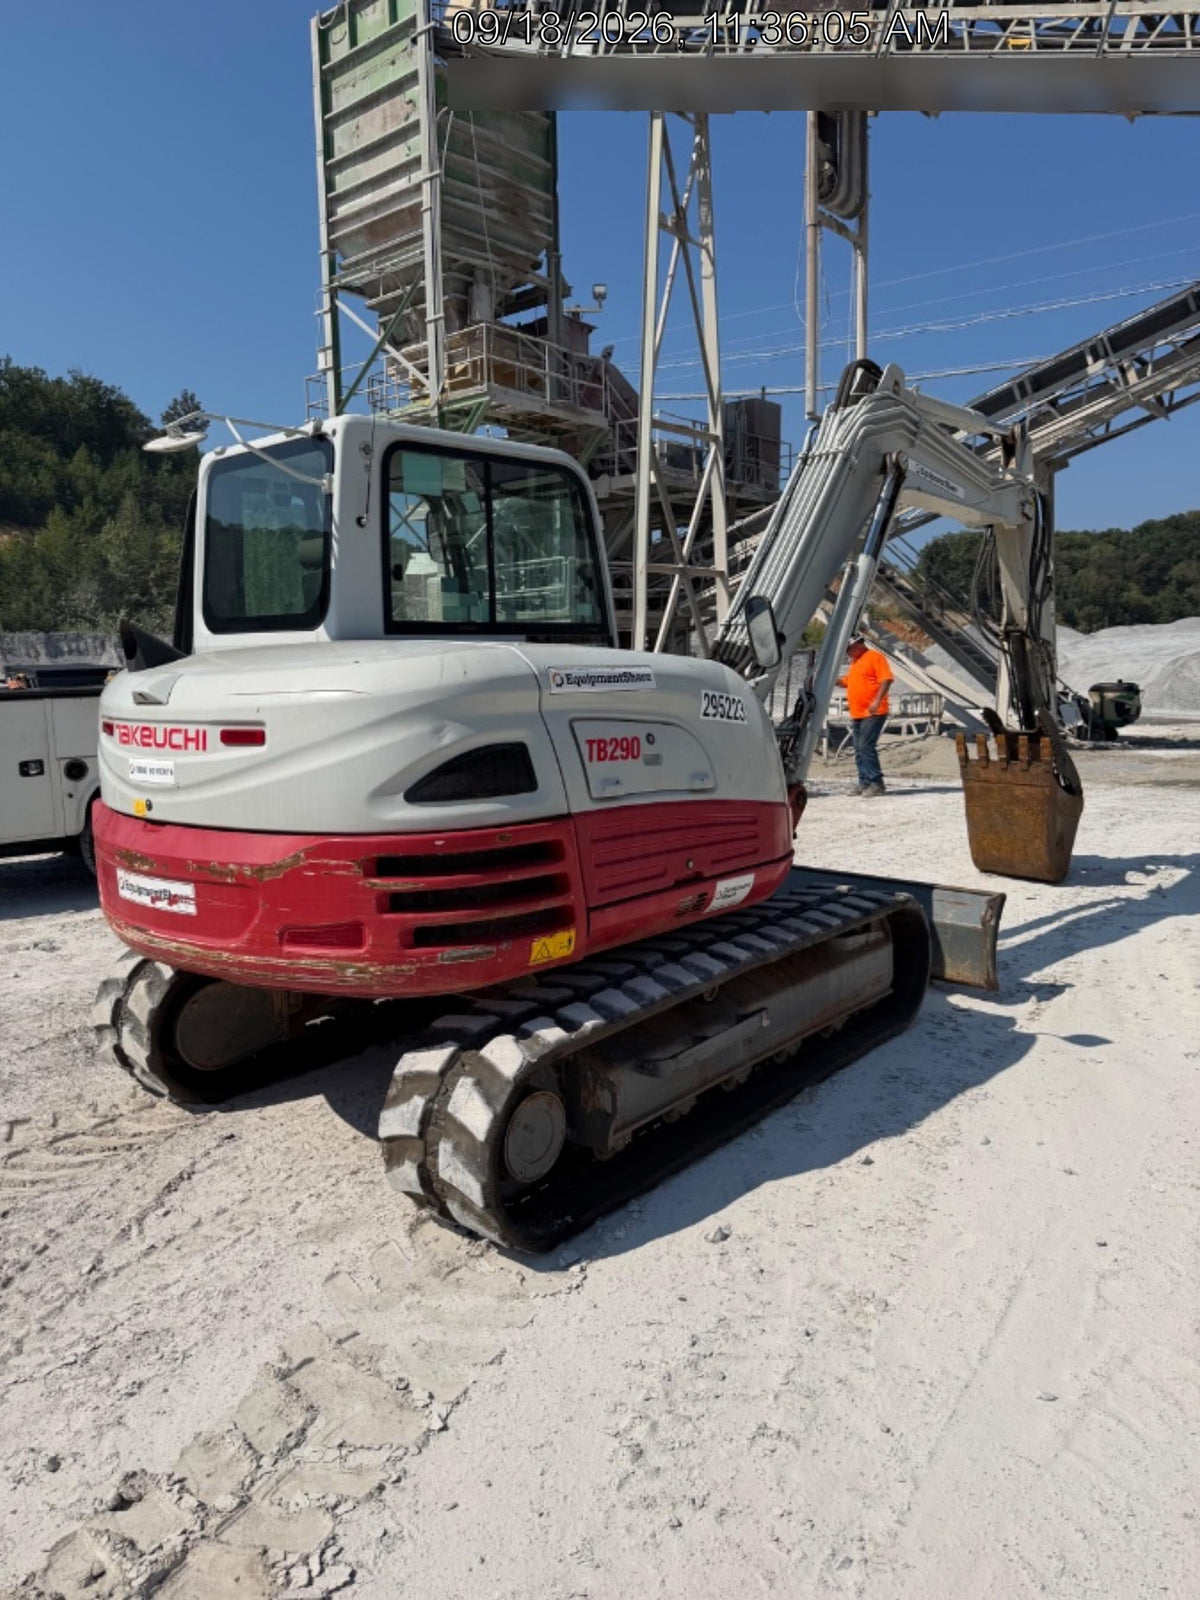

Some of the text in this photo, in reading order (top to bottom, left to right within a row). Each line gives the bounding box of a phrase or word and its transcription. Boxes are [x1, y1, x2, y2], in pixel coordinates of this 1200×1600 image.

[565, 672, 653, 687] EquipmentShare
[115, 724, 207, 752] TAKEUCHI
[585, 736, 641, 763] TB290
